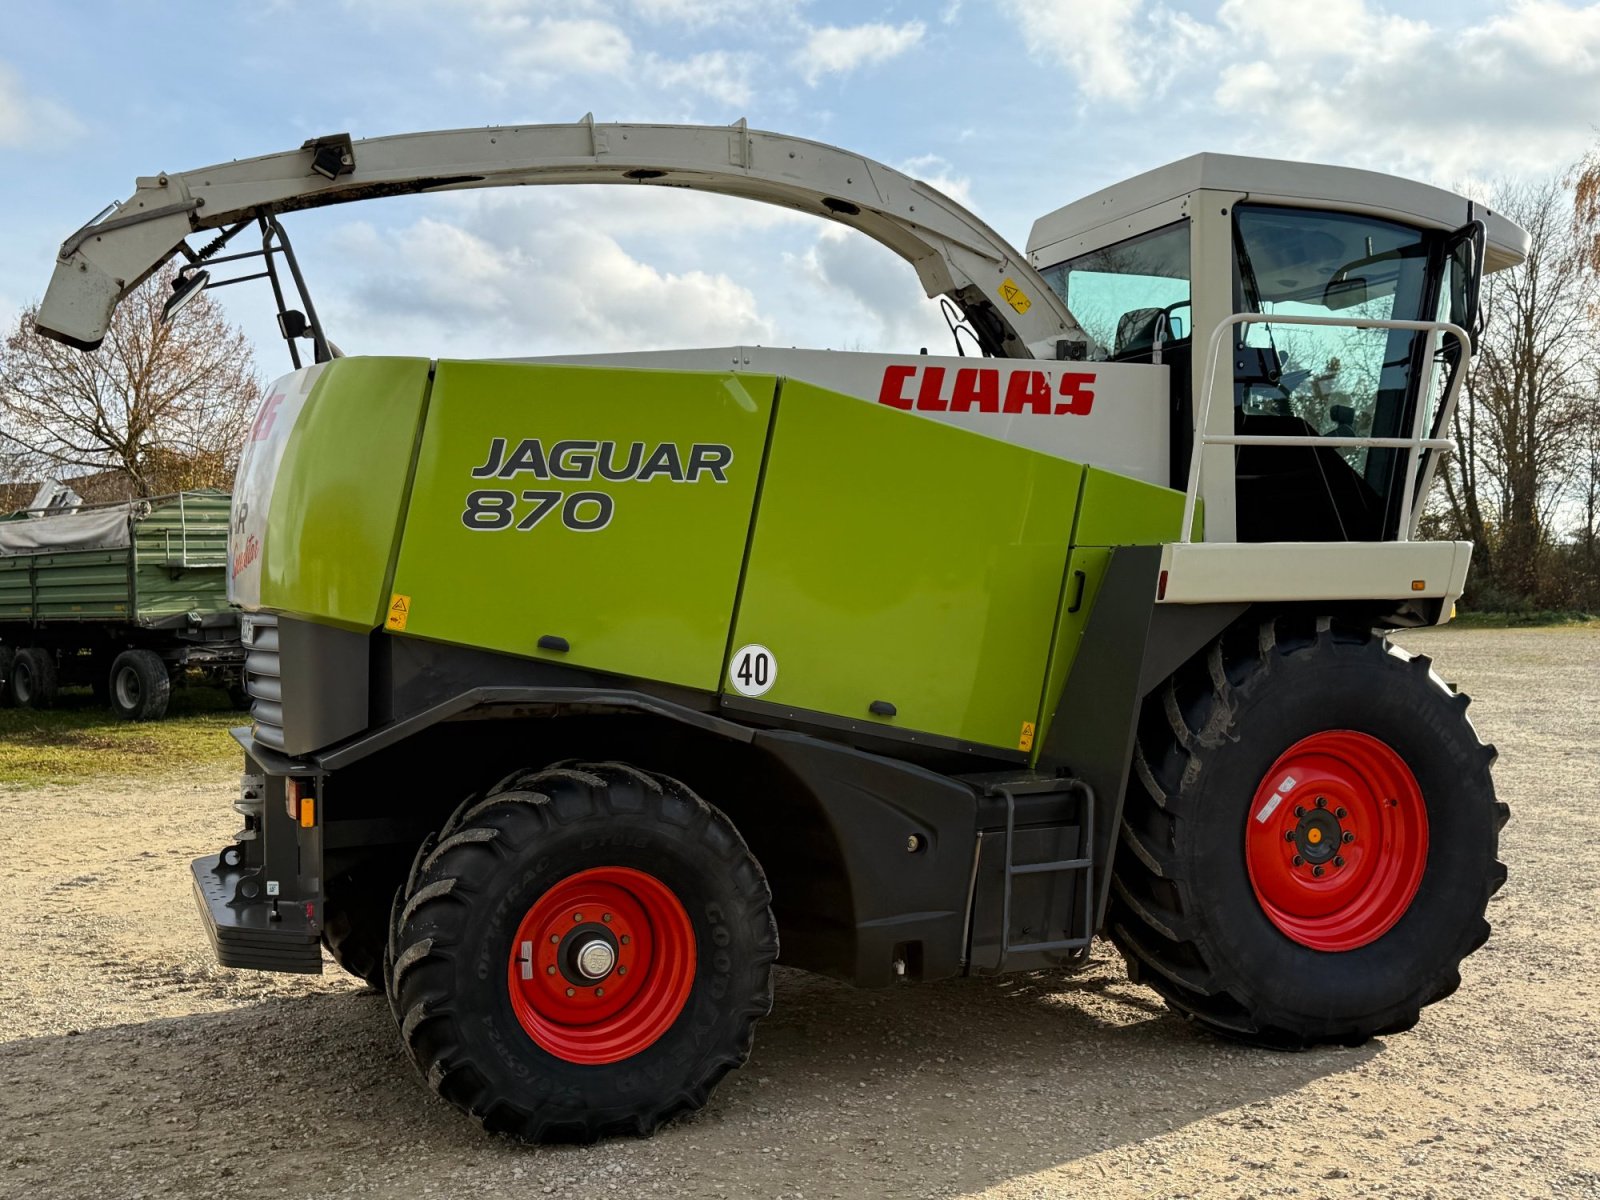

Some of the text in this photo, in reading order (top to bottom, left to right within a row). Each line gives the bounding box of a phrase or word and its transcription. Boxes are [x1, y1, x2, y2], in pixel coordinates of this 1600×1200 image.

[878, 365, 1097, 416] CLAAS
[471, 438, 734, 483] JAGUAR
[461, 490, 614, 532] 870
[737, 653, 768, 686] 40
